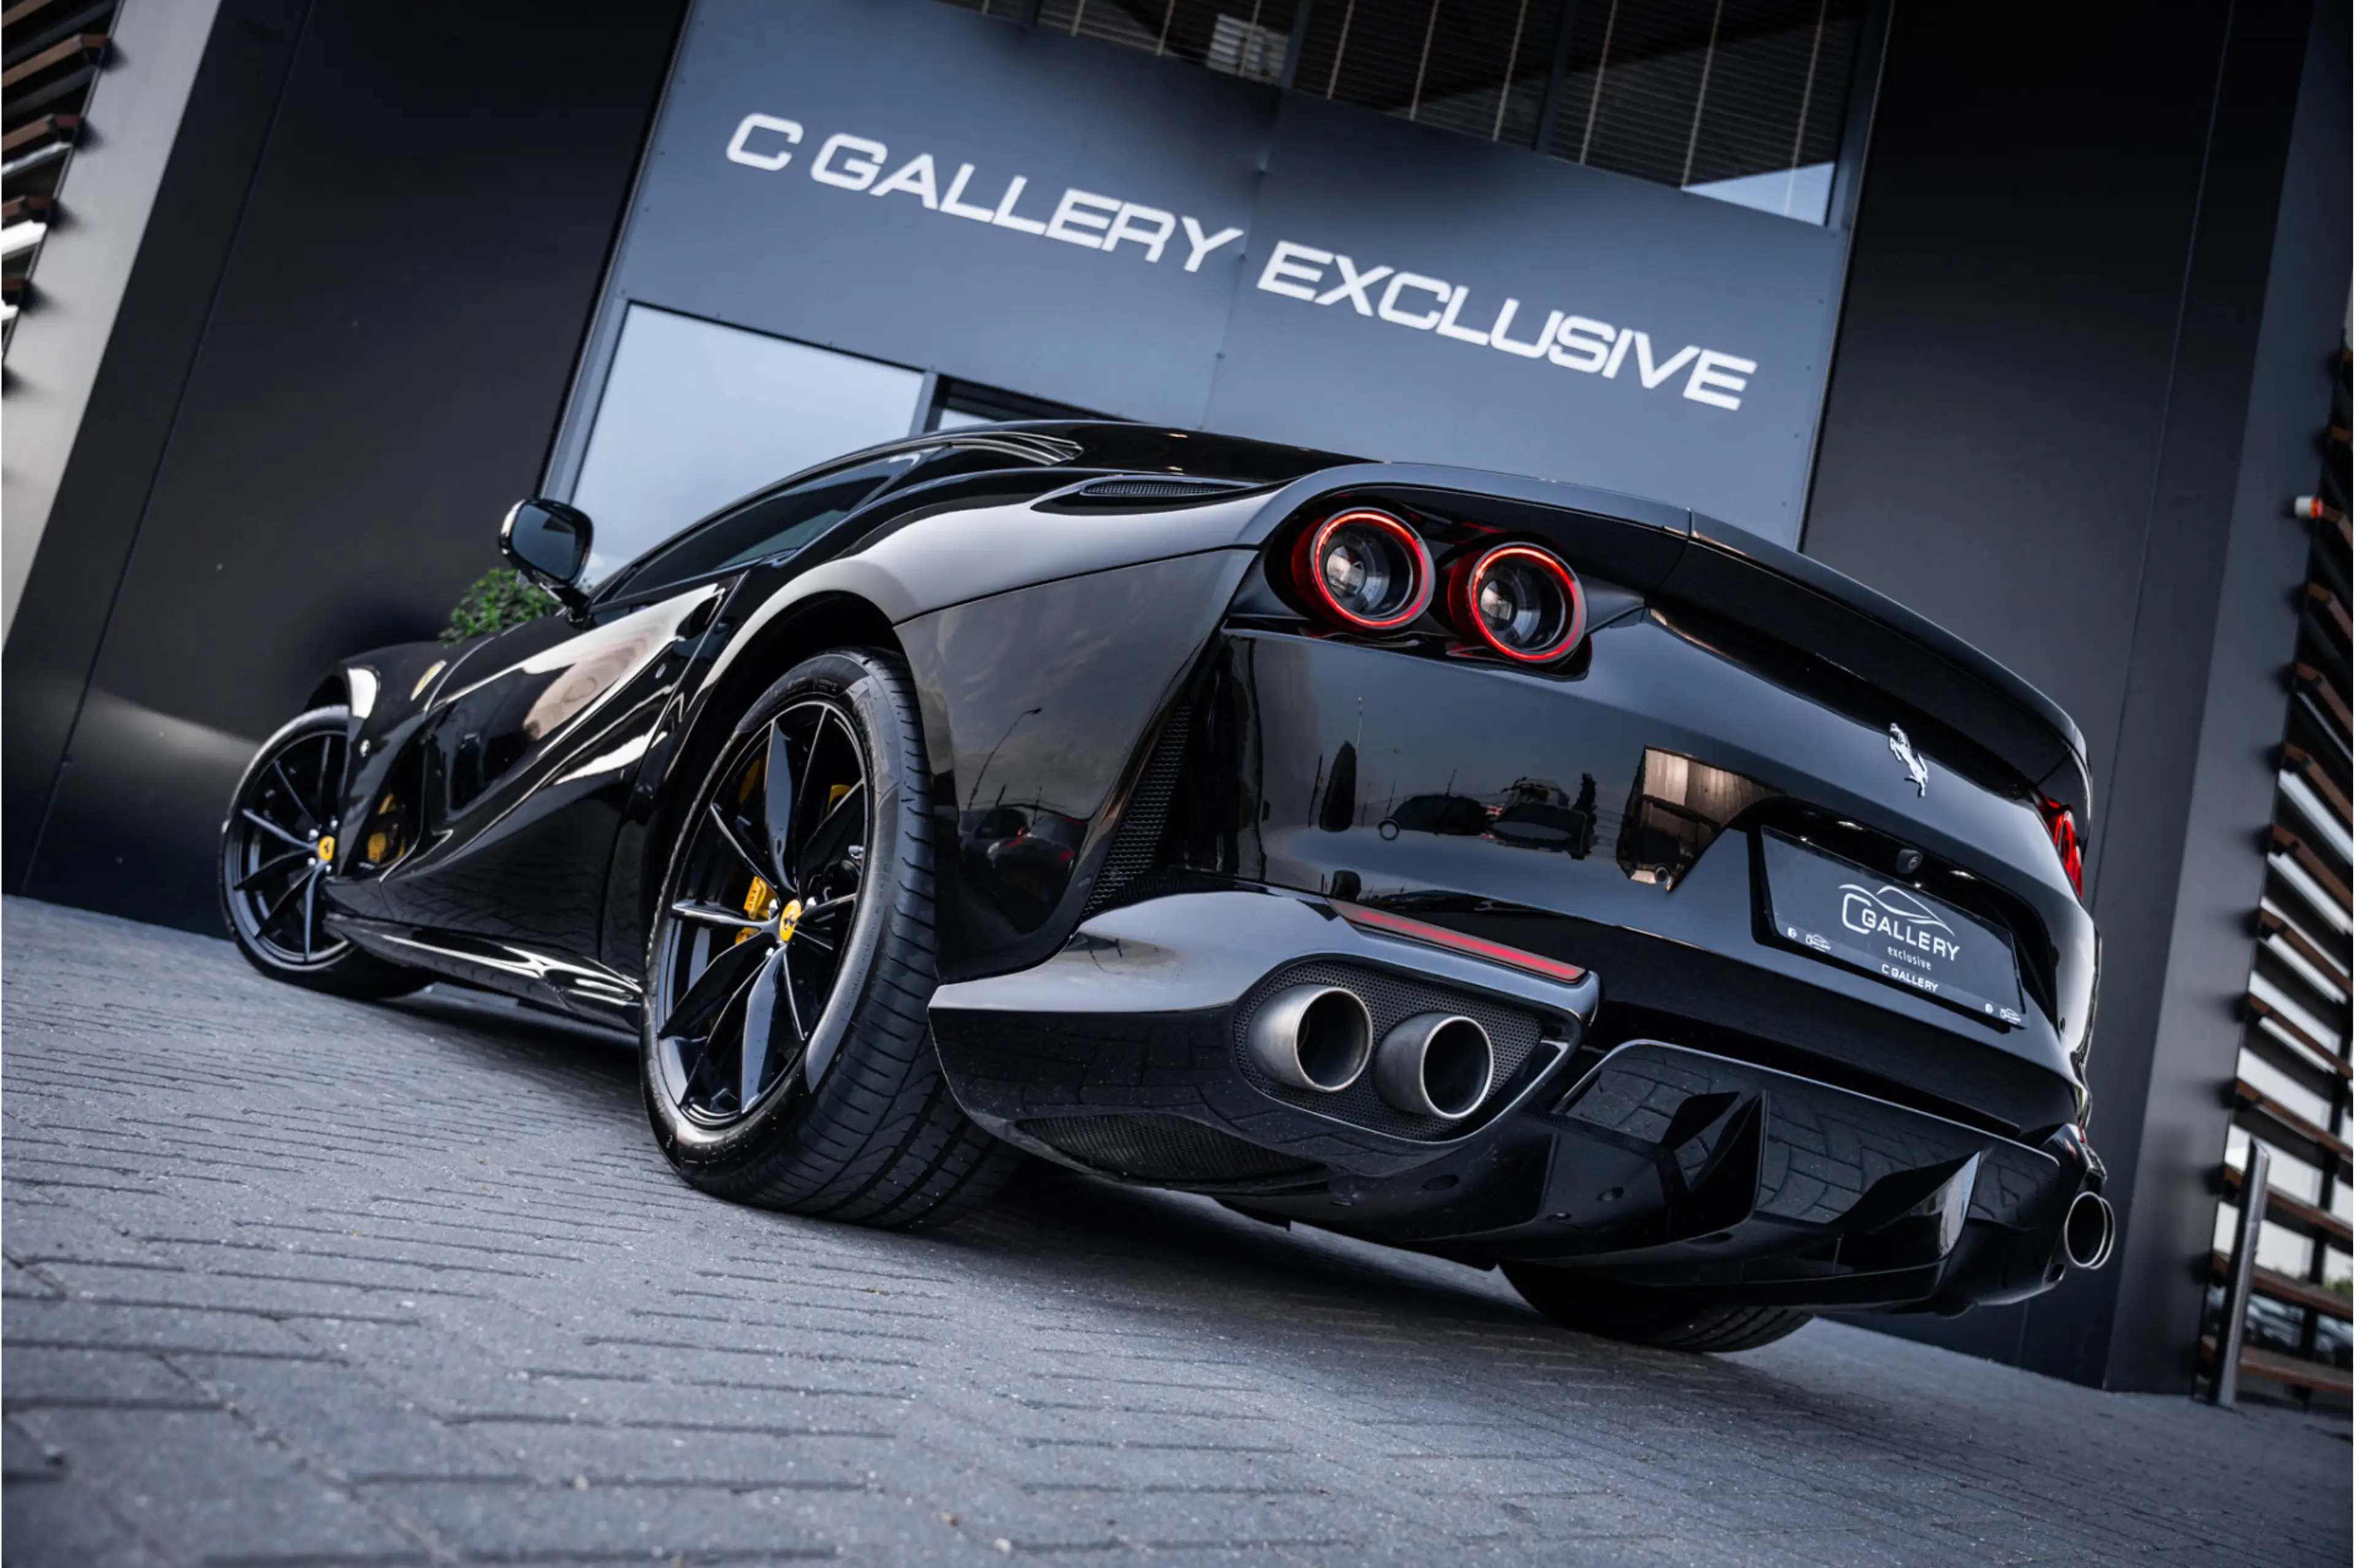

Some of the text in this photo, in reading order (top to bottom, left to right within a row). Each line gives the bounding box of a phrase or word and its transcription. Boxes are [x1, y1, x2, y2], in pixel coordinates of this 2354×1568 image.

[726, 114, 1758, 411] C GALLERY EXCLUSIVE
[1887, 946, 1932, 971] exclusive
[1881, 964, 1939, 992] C GALLERY
